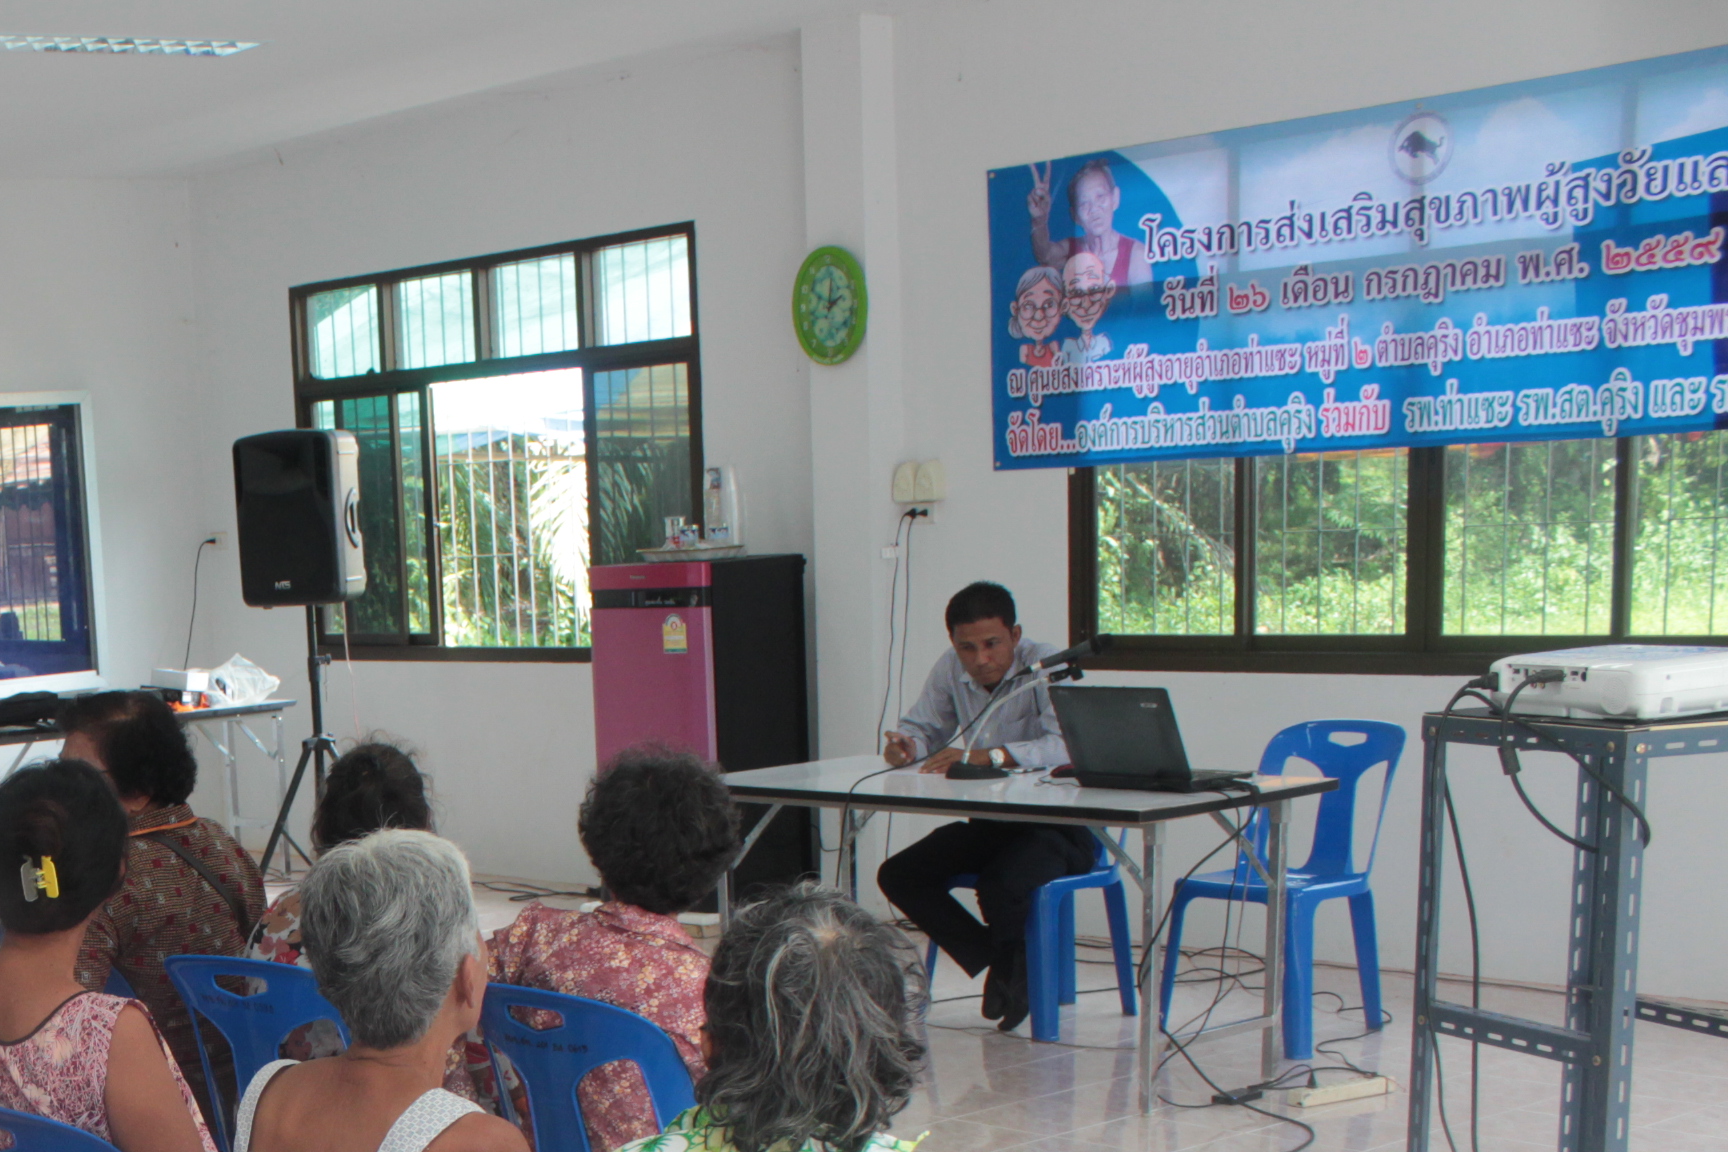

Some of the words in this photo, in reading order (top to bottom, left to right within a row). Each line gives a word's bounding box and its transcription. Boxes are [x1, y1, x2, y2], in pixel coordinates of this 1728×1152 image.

[1163, 265, 1215, 317] วันที่
[1229, 283, 1267, 310] ๒๖
[1282, 264, 1349, 305] เดือน
[1365, 257, 1502, 300] กรกฎาคม
[1518, 245, 1586, 281] พ.ศ.
[1604, 230, 1722, 271] ๒๕๕๙
[1009, 372, 1024, 394] ณ
[1307, 318, 1346, 380] หมู่ที่
[1354, 340, 1368, 364] ๒
[1377, 322, 1459, 371] ตำบลคุริง
[1469, 310, 1595, 356] อำเภอท่าแซะ
[1607, 298, 1728, 352] จังหวัดชุมพ
[1322, 388, 1389, 435] ร่วมกับ
[1651, 380, 1703, 414] และ
